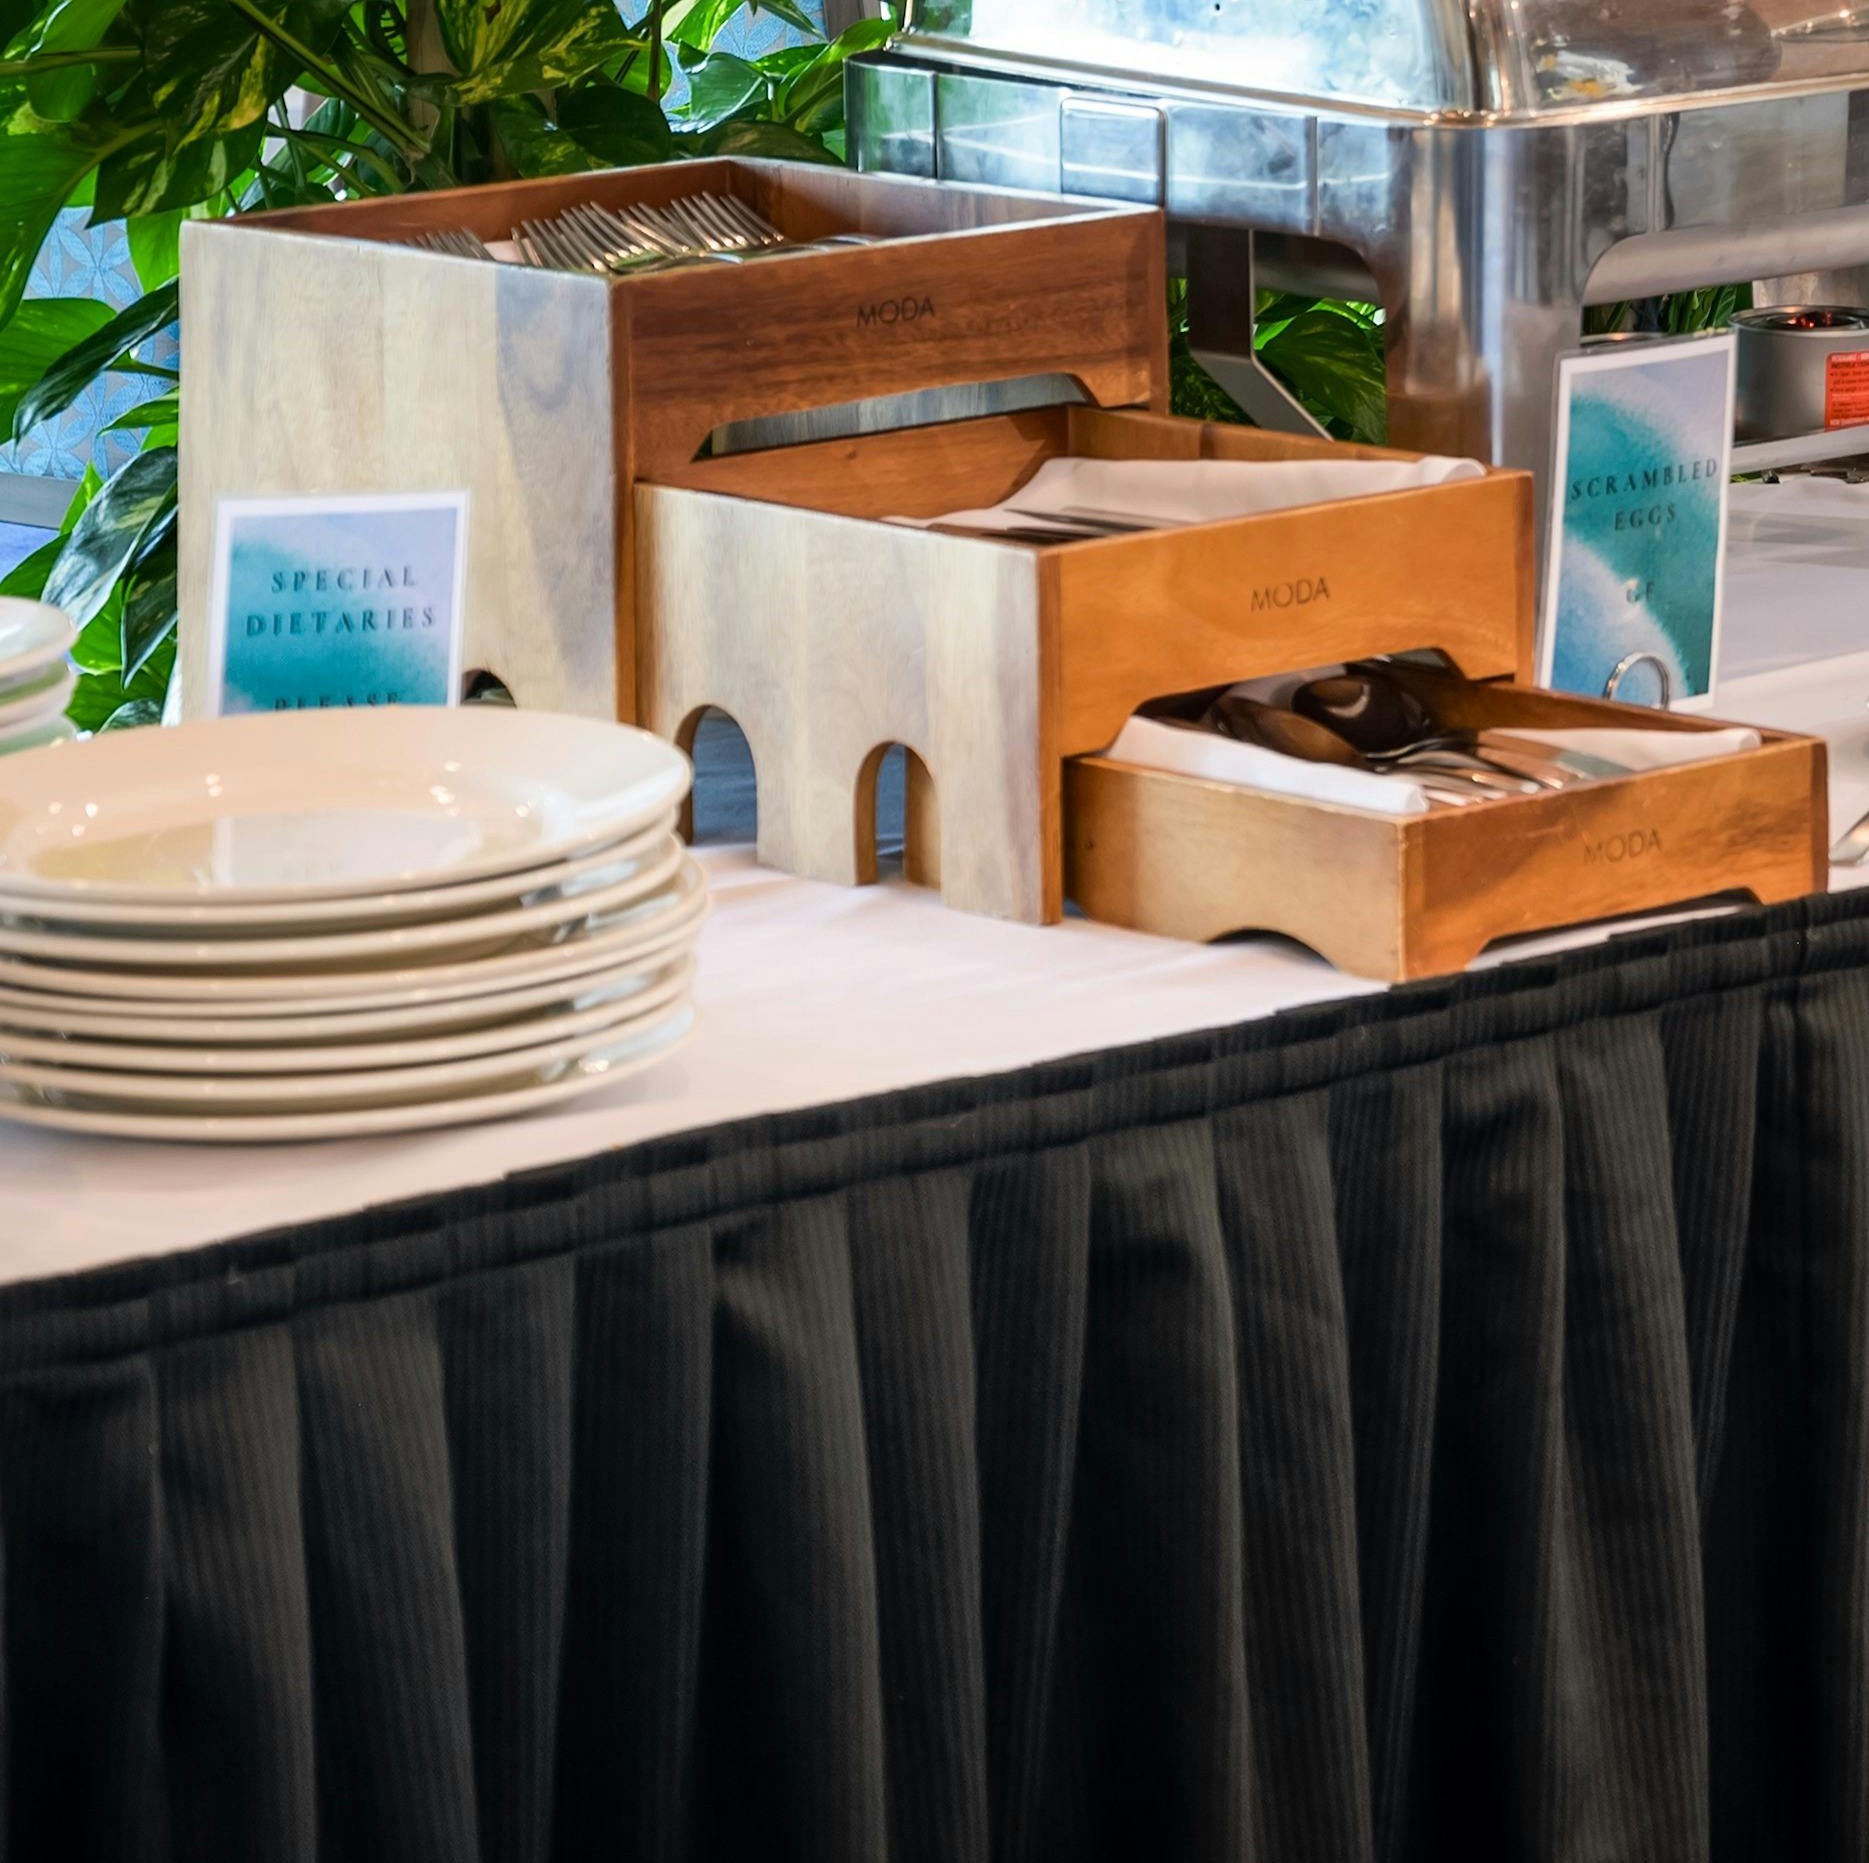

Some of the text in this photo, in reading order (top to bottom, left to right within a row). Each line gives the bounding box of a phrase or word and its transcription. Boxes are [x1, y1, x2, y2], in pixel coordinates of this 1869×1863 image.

[855, 295, 935, 329] MODA
[1570, 457, 1718, 502] SCRAMBLED
[1614, 502, 1677, 532] EGGS
[270, 565, 418, 594] SPECIAL
[1250, 576, 1331, 612] MODA
[245, 606, 435, 638] DIETARIES
[1582, 827, 1665, 866] MODA
